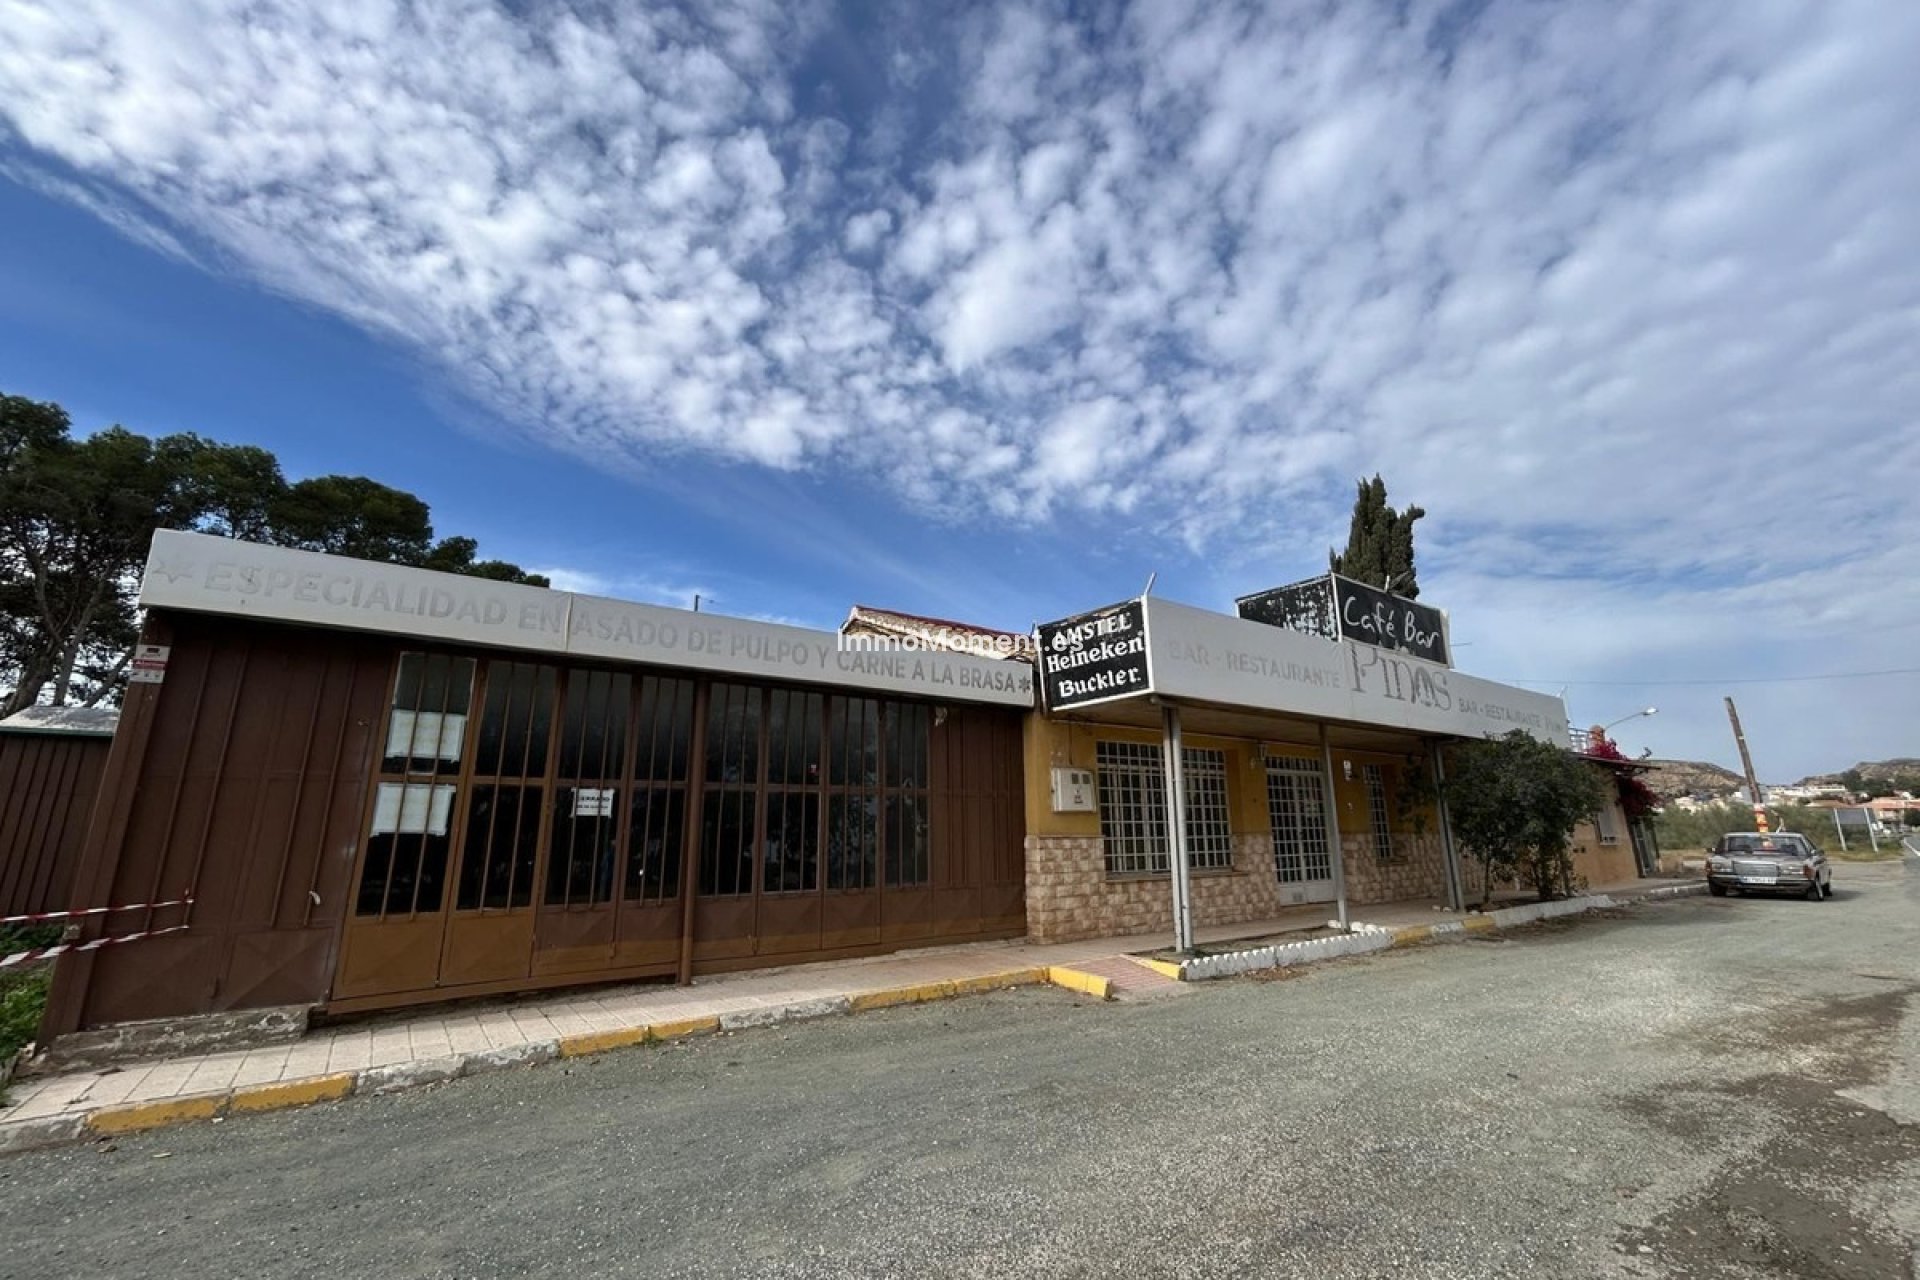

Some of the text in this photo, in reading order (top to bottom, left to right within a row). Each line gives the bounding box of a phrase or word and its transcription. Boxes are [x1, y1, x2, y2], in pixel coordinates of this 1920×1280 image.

[203, 560, 1016, 693] ESPECIALIDAD EN ASADO DE PULPO Y CARNE A LA BRASA
[1343, 596, 1397, 639] Café
[1404, 610, 1440, 649] Bar
[1046, 636, 1145, 673] Heineken
[1168, 641, 1341, 689] BAR RESTAURANTE
